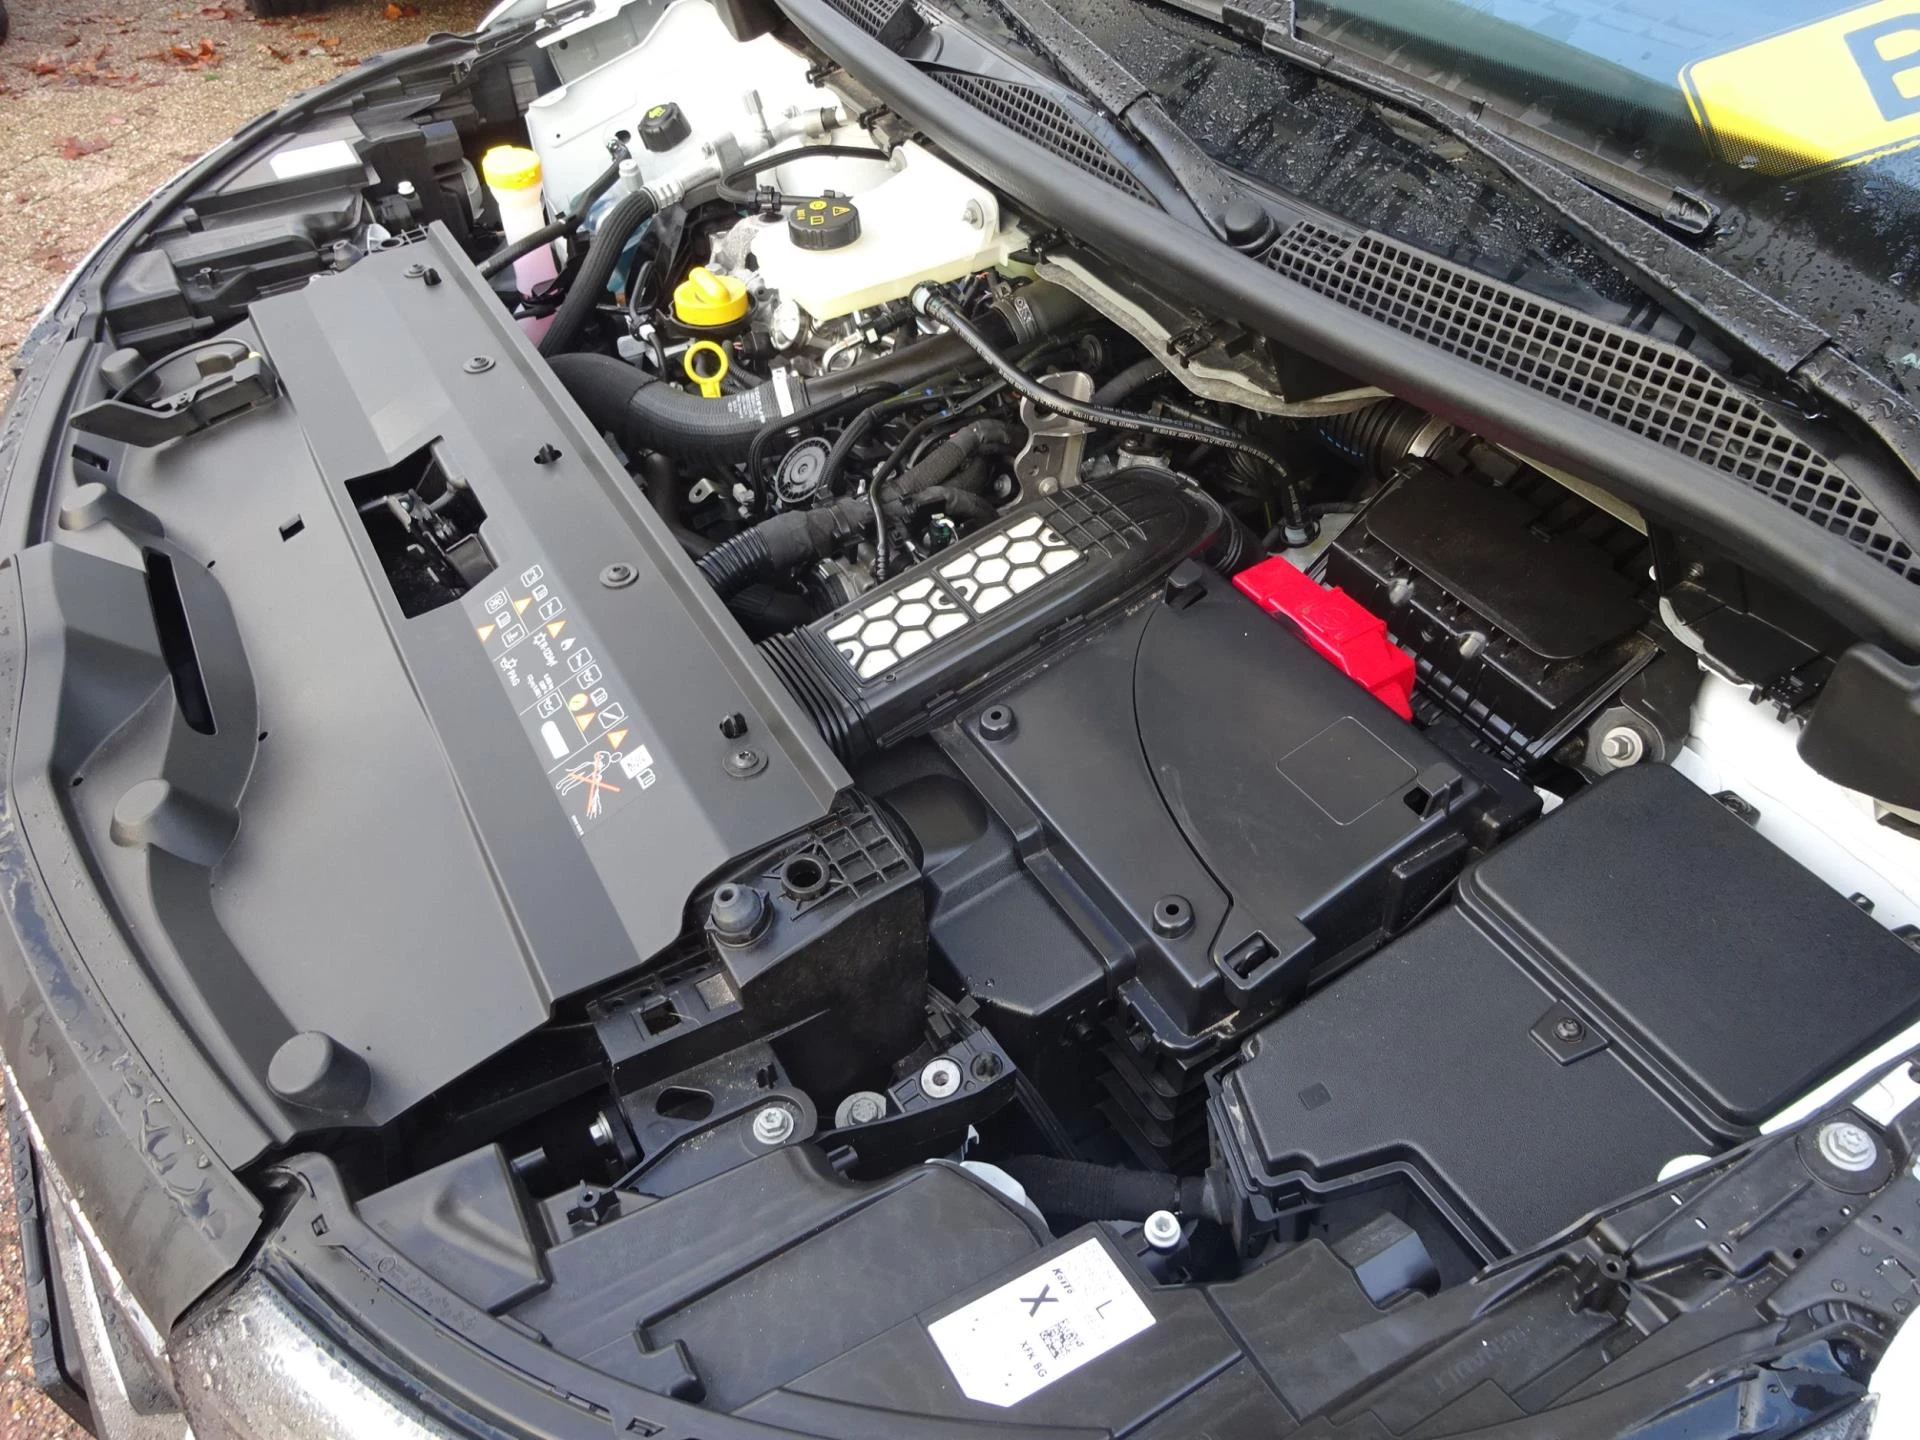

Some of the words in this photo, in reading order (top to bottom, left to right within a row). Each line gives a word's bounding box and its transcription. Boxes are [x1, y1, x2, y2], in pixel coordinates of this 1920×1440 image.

[508, 671, 521, 687] PAG
[1019, 1284, 1059, 1318] X
[1096, 1299, 1113, 1319] L
[1034, 1362, 1048, 1377] BG
